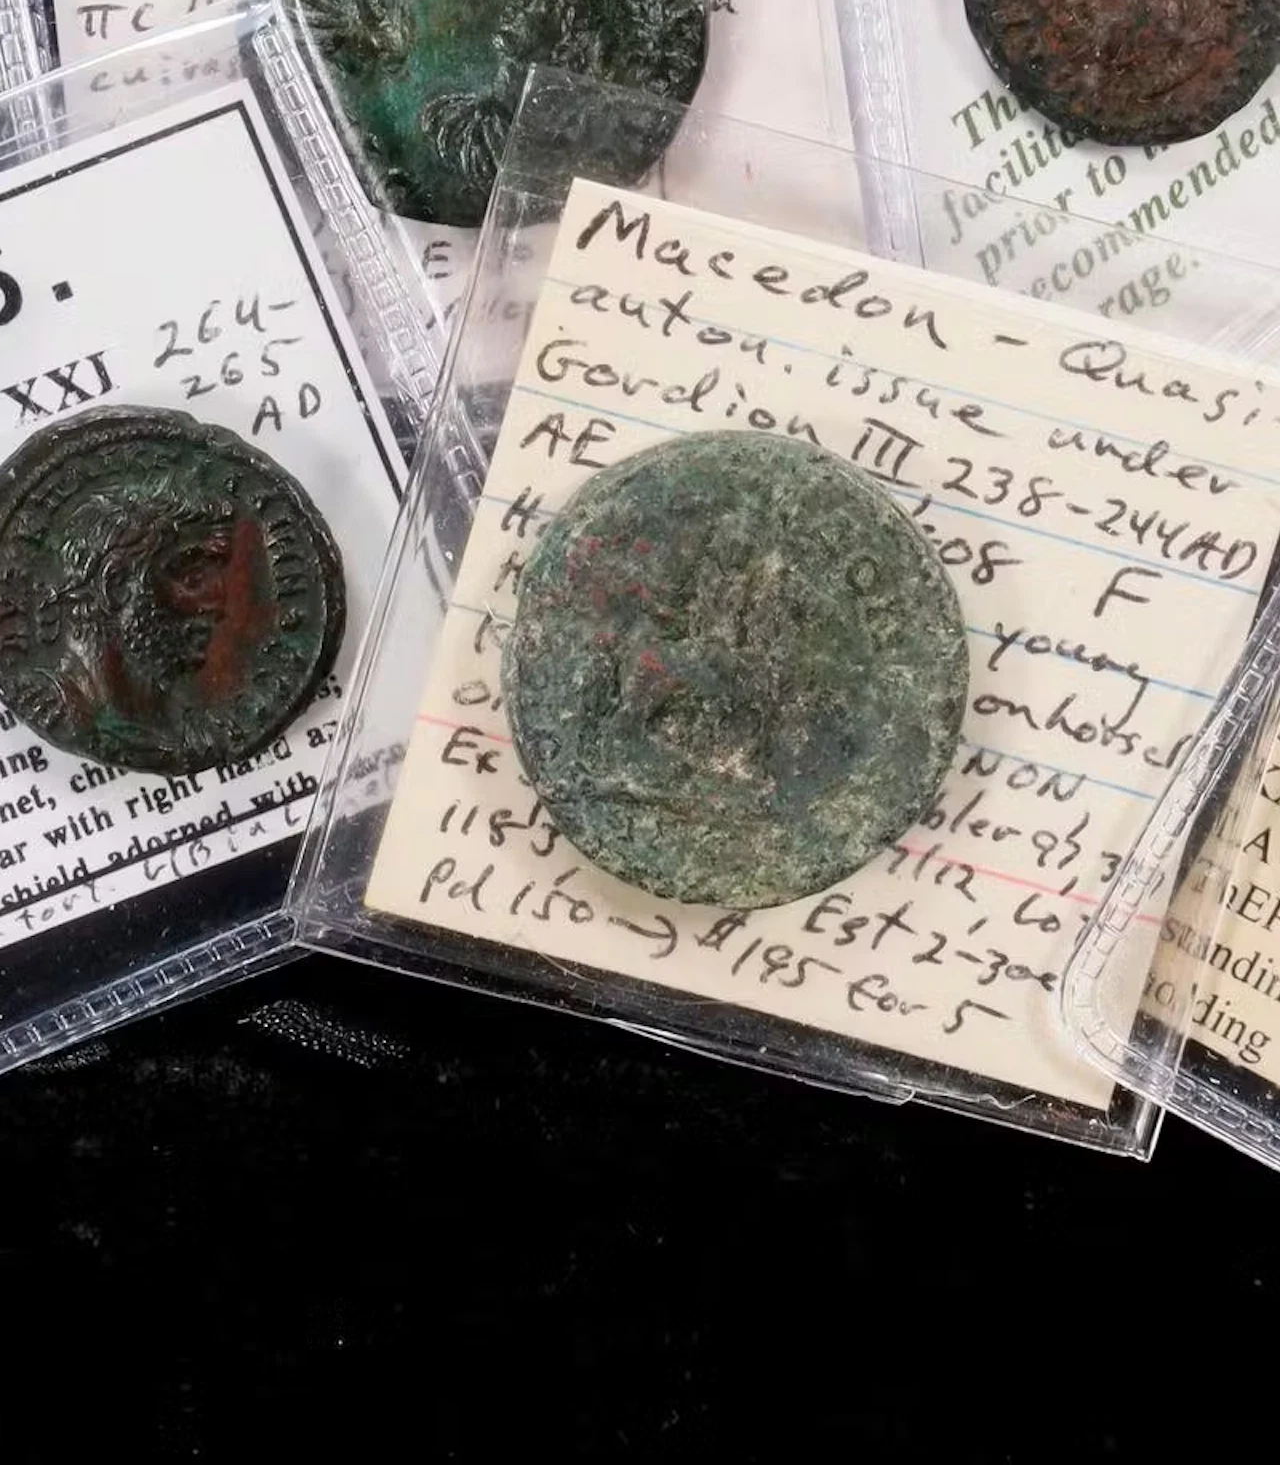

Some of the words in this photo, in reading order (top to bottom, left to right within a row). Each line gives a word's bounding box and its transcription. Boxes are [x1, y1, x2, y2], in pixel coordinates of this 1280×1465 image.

[1084, 152, 1128, 205] to
[574, 199, 950, 353] Macedon
[0, 349, 120, 422] XXI
[825, 343, 1006, 439] issue
[1046, 422, 1241, 499] under
[43, 806, 117, 850] with
[125, 772, 207, 822] right
[107, 803, 238, 870] adorned
